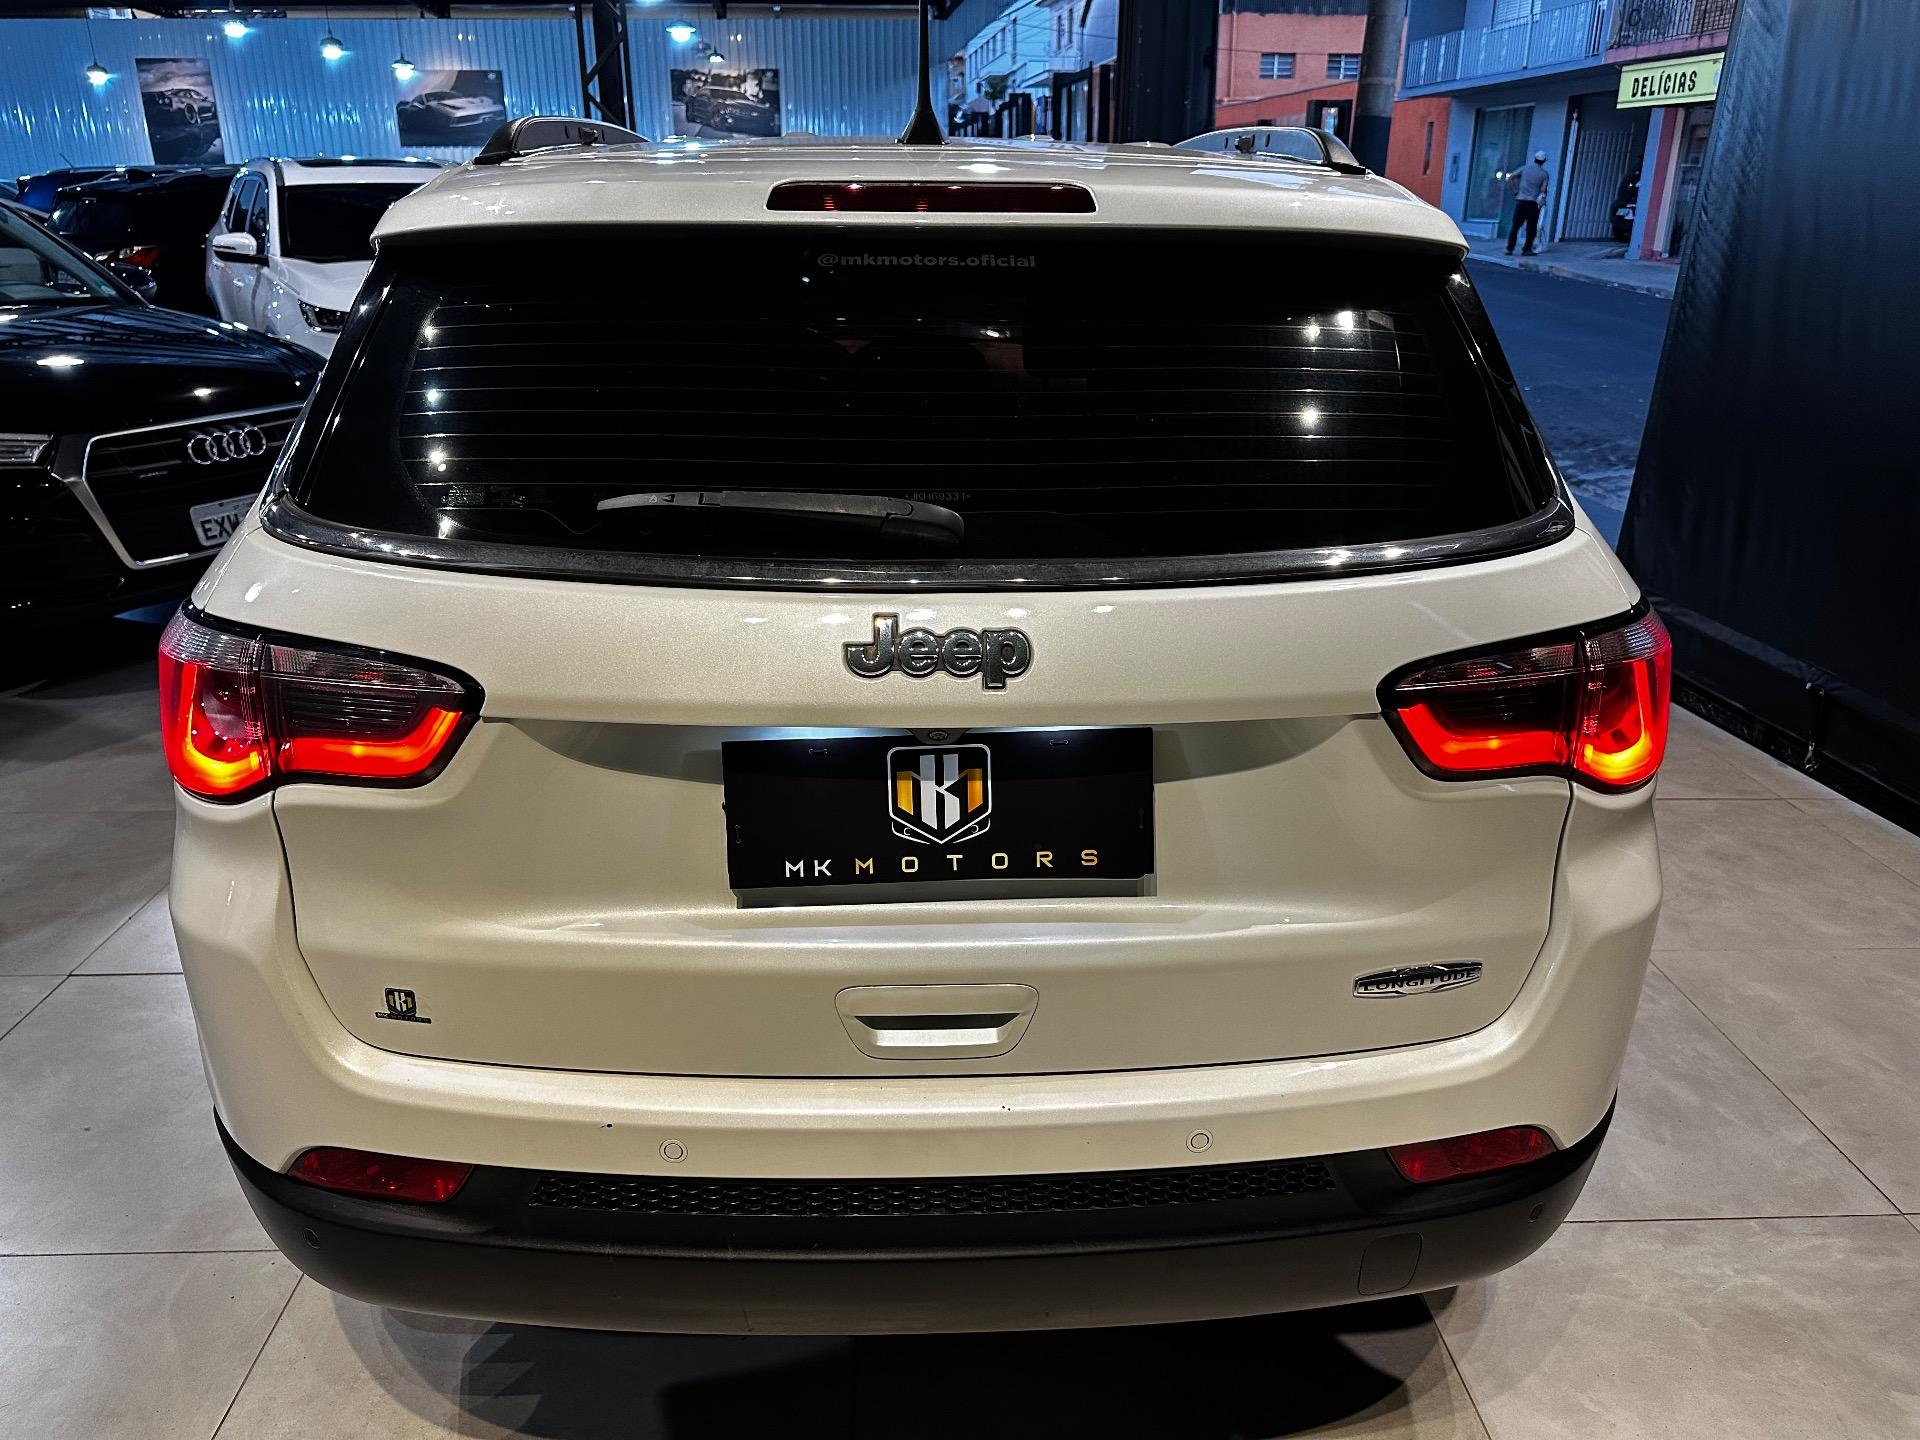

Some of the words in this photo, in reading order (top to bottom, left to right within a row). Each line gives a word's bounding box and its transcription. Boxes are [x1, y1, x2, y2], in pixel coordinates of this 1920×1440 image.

[1631, 70, 1698, 98] DELÍCIAS
[817, 253, 1037, 268] @mkmotors.oficial
[844, 613, 1032, 690] Jeep
[1361, 969, 1477, 992] LONGITUDE
